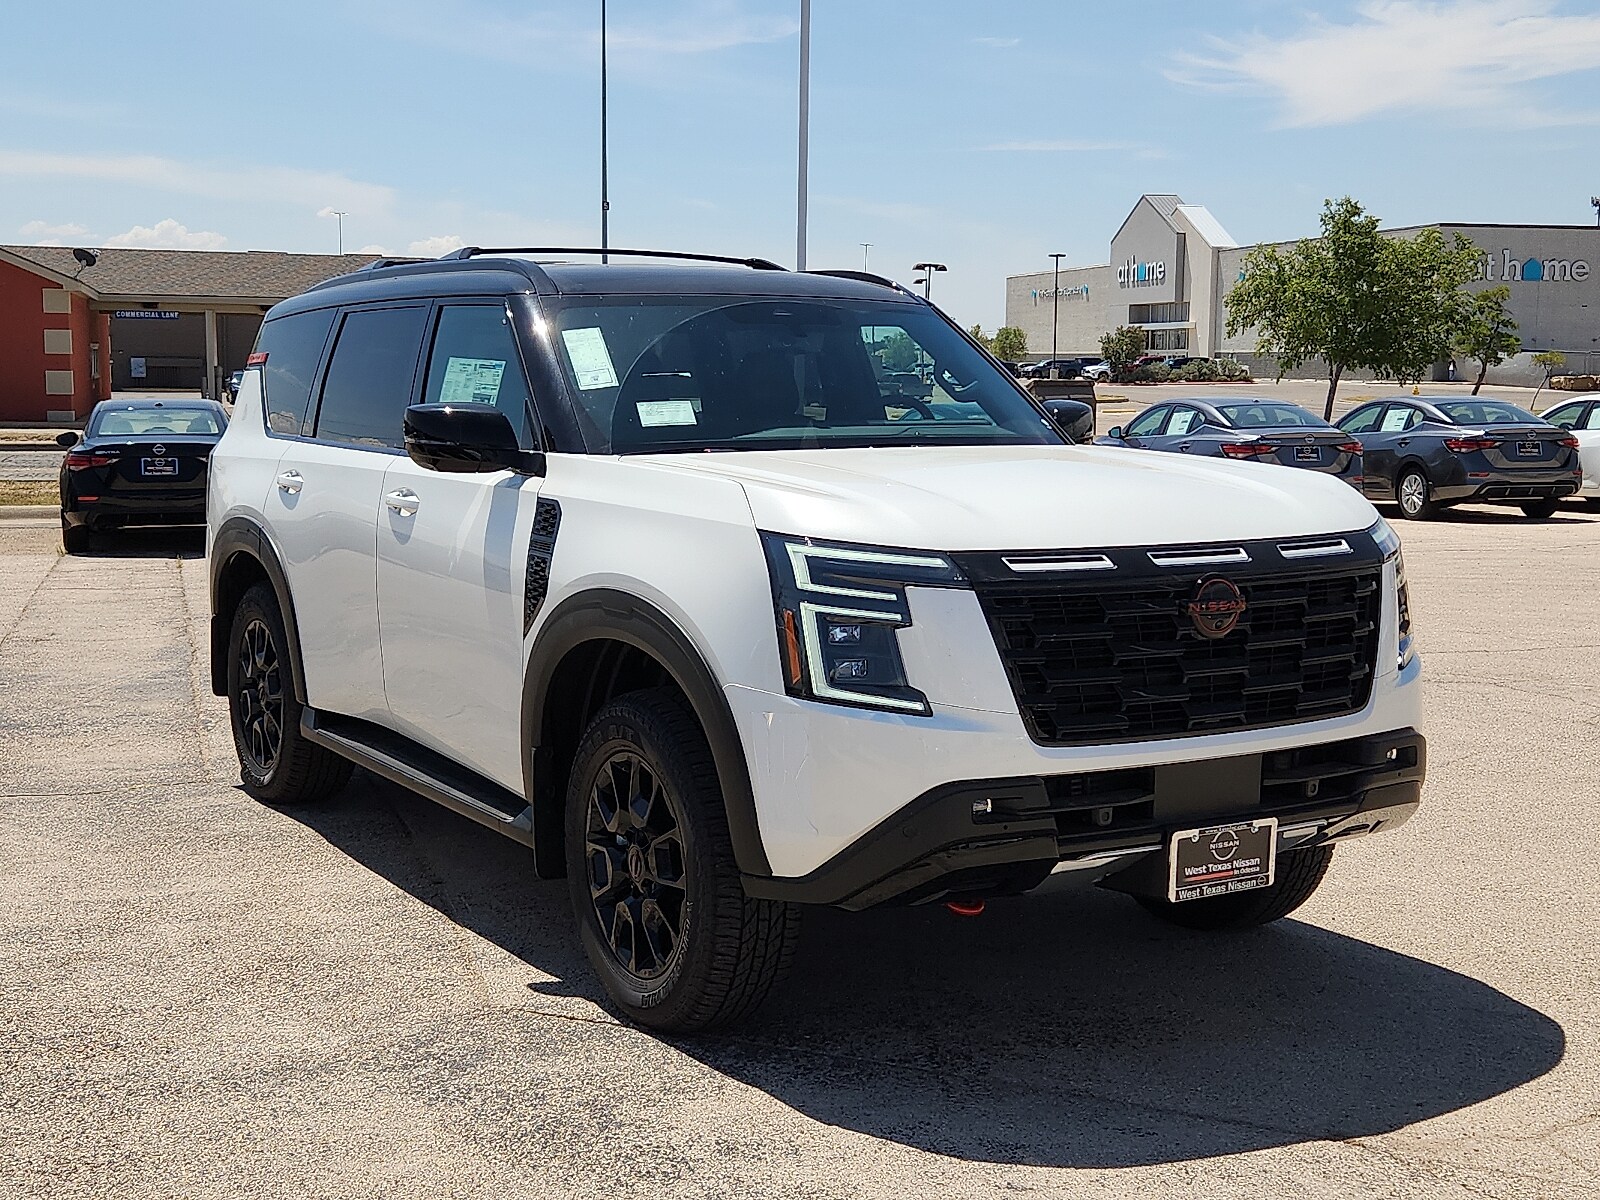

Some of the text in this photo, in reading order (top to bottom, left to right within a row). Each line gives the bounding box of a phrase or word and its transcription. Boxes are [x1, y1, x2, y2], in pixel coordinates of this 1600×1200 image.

[1209, 839, 1240, 850] NISSAN
[1184, 857, 1261, 876] West Texas Nissan
[1178, 879, 1257, 900] West Texas Nissan
